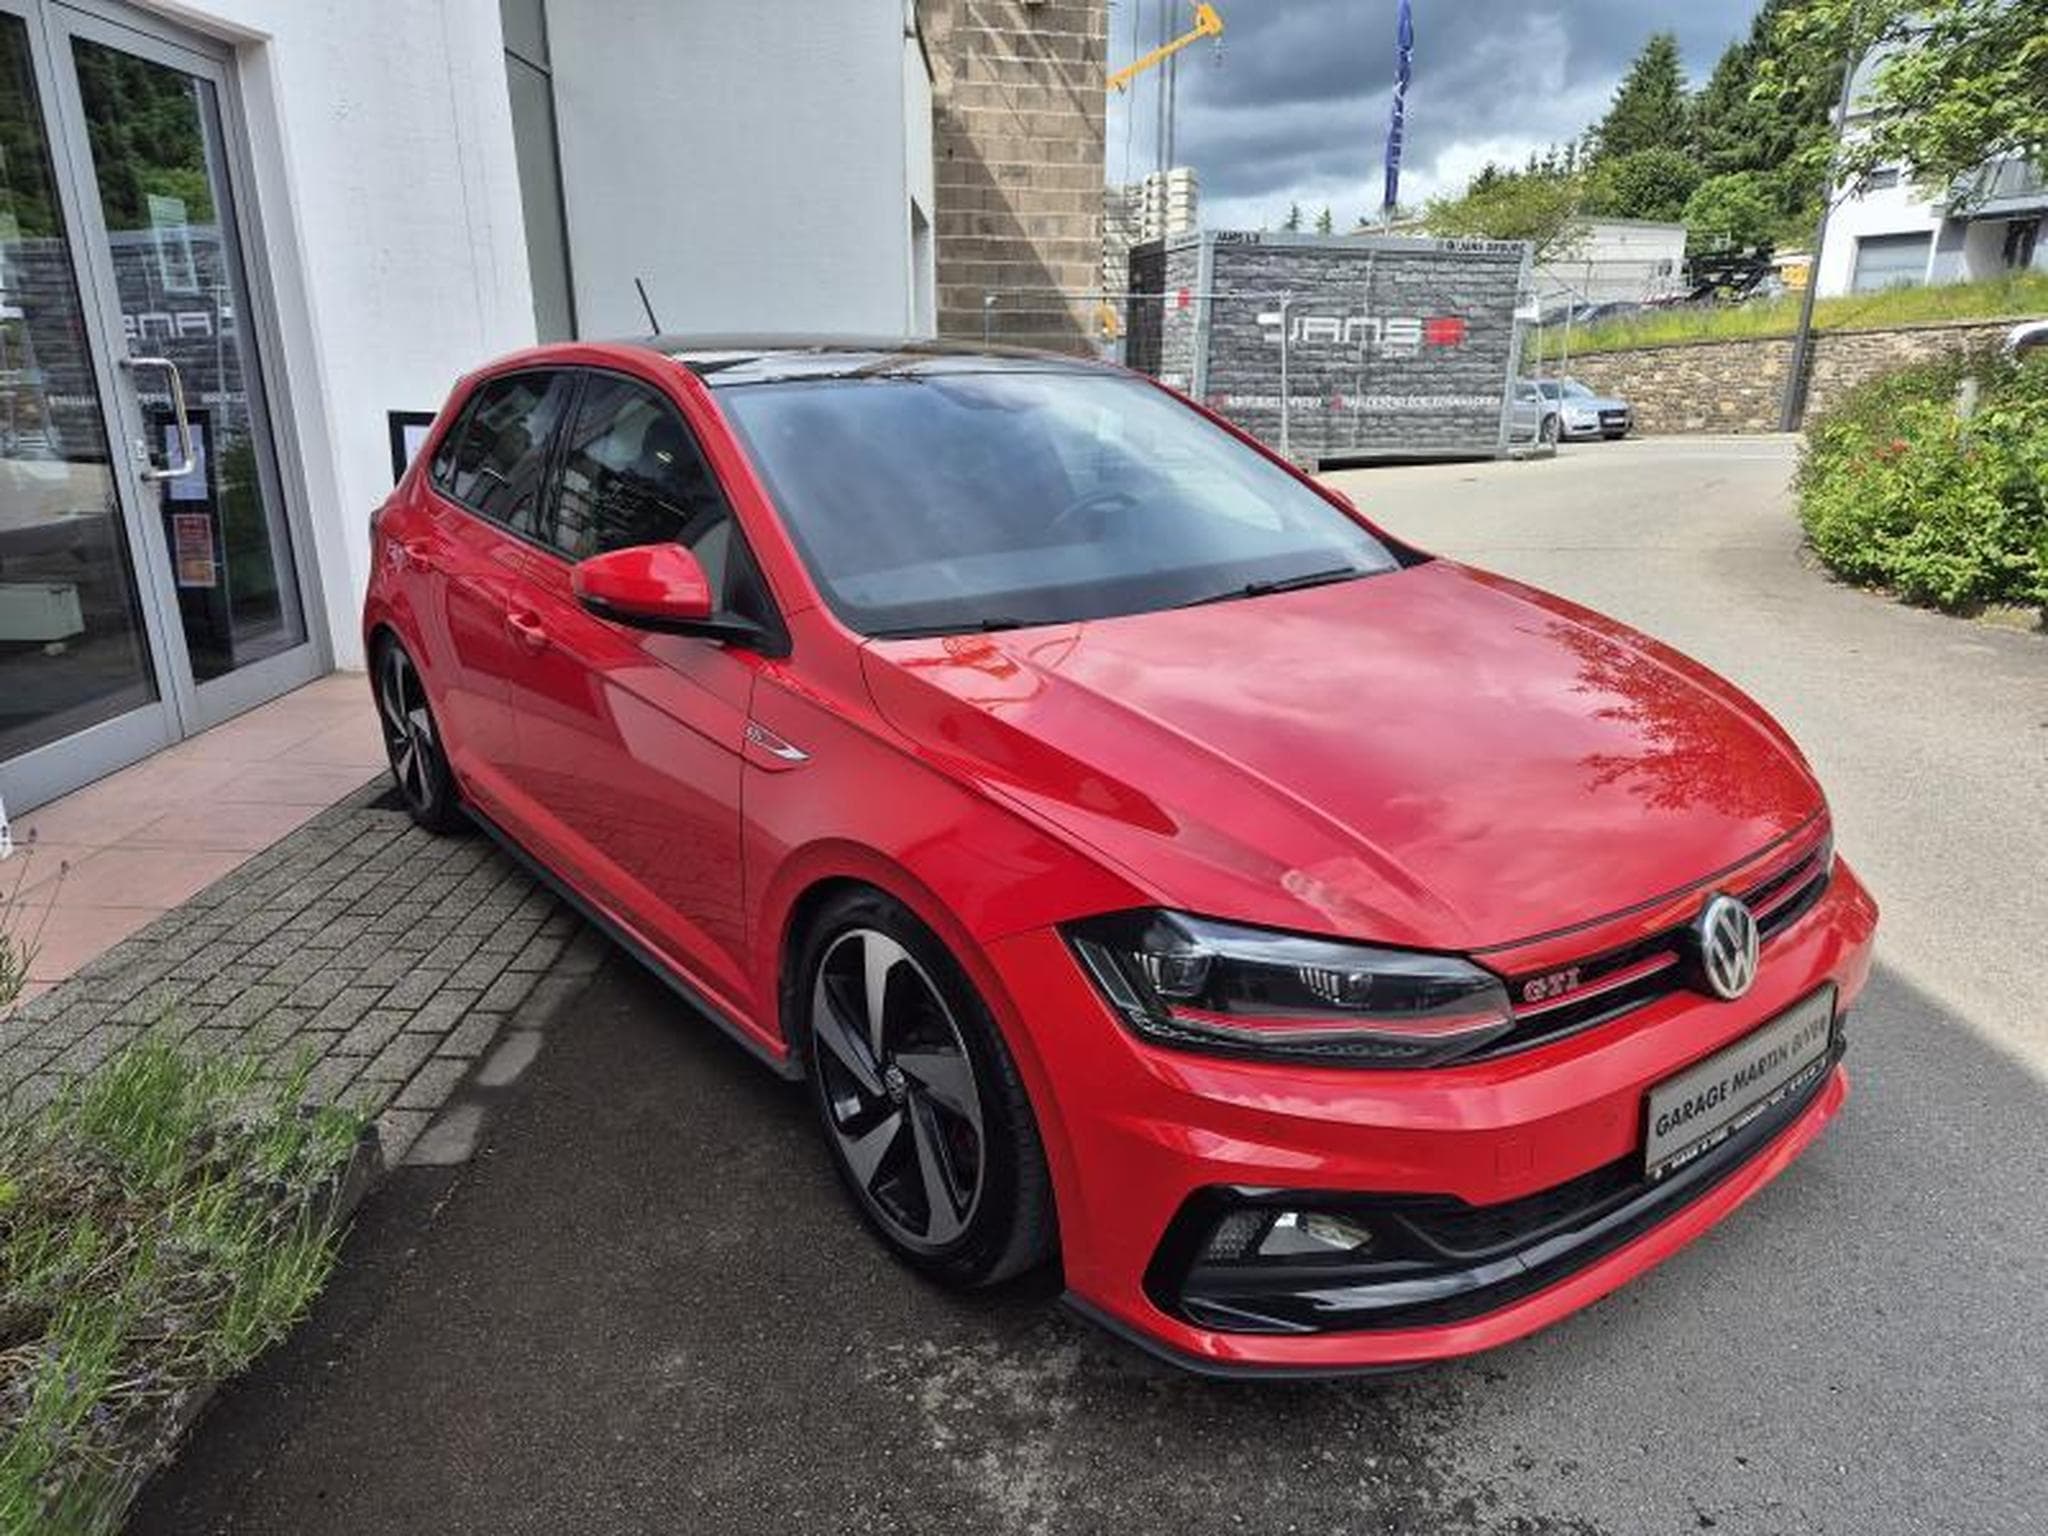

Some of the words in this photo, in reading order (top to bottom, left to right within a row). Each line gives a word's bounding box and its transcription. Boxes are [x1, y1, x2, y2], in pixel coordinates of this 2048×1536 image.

[1523, 967, 1581, 1002] GTI
[1656, 1081, 1727, 1137] GARAGE
[1731, 1042, 1788, 1094] MARTIN
